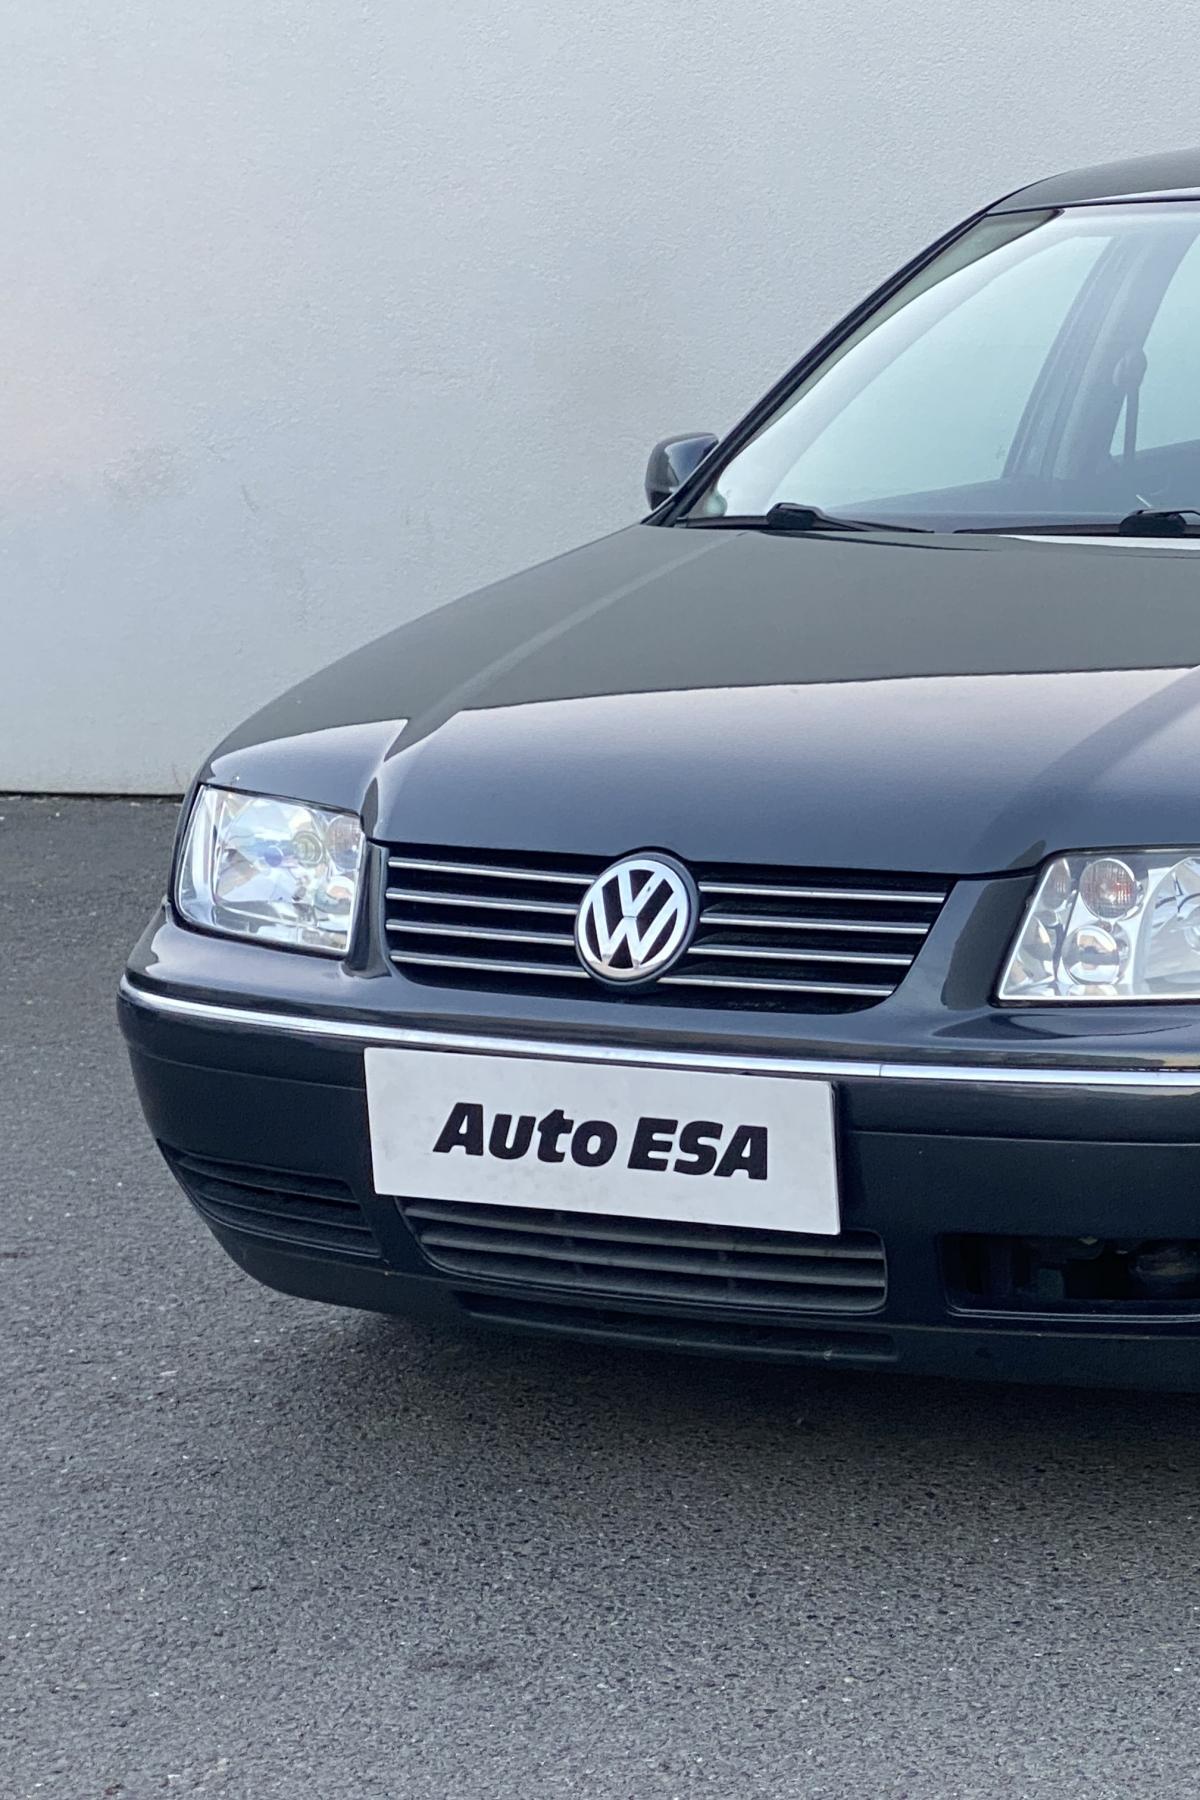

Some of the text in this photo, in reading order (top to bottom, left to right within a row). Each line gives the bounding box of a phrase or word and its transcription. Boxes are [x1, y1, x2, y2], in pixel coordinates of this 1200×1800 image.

[580, 859, 688, 978] VW
[432, 1102, 768, 1181] Auto ESA
